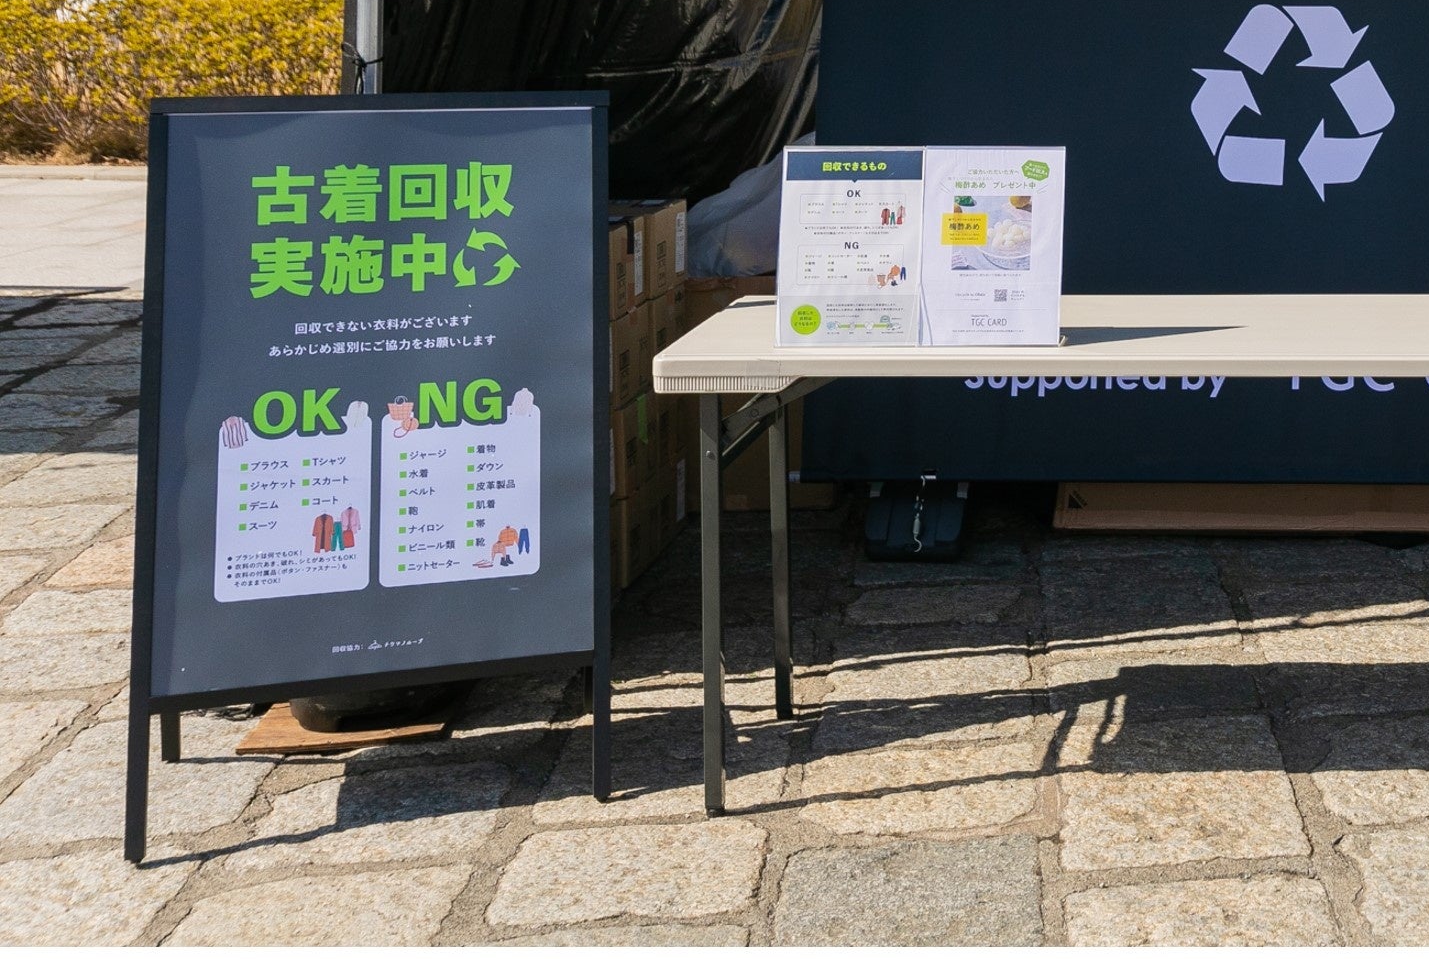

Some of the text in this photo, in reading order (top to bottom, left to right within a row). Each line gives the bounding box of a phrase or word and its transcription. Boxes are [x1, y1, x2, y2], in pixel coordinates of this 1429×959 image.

[822, 161, 888, 172] 回収できるもの
[251, 161, 515, 225] 古着回収
[846, 189, 861, 198] OK
[844, 241, 859, 250] NG
[249, 233, 447, 298] 実施中
[294, 314, 474, 336] 回収できない衣料がございます
[971, 318, 1008, 327] TGC CARD
[268, 333, 497, 358] あらかじめ選別にご協力をお願いします
[418, 377, 503, 425] NG
[252, 386, 342, 435] OK
[409, 448, 447, 460] ジャージ
[476, 444, 496, 454] 着物
[250, 460, 289, 472] ブラウス
[312, 456, 347, 467] Tシャツ
[475, 462, 504, 473] ダウン
[408, 468, 429, 479] 水着
[250, 479, 296, 491] ジャケット
[312, 475, 349, 486] スカート
[475, 479, 516, 492] 皮革製品
[408, 486, 436, 496] ベルト
[249, 500, 279, 511] デニム
[312, 495, 338, 505] コート
[475, 499, 496, 510] 肌着
[248, 520, 278, 531] スーツ
[408, 523, 445, 535] ナイロン
[475, 518, 486, 529] 帯
[408, 539, 456, 553] ビニール類
[407, 559, 460, 572] ニットセーター
